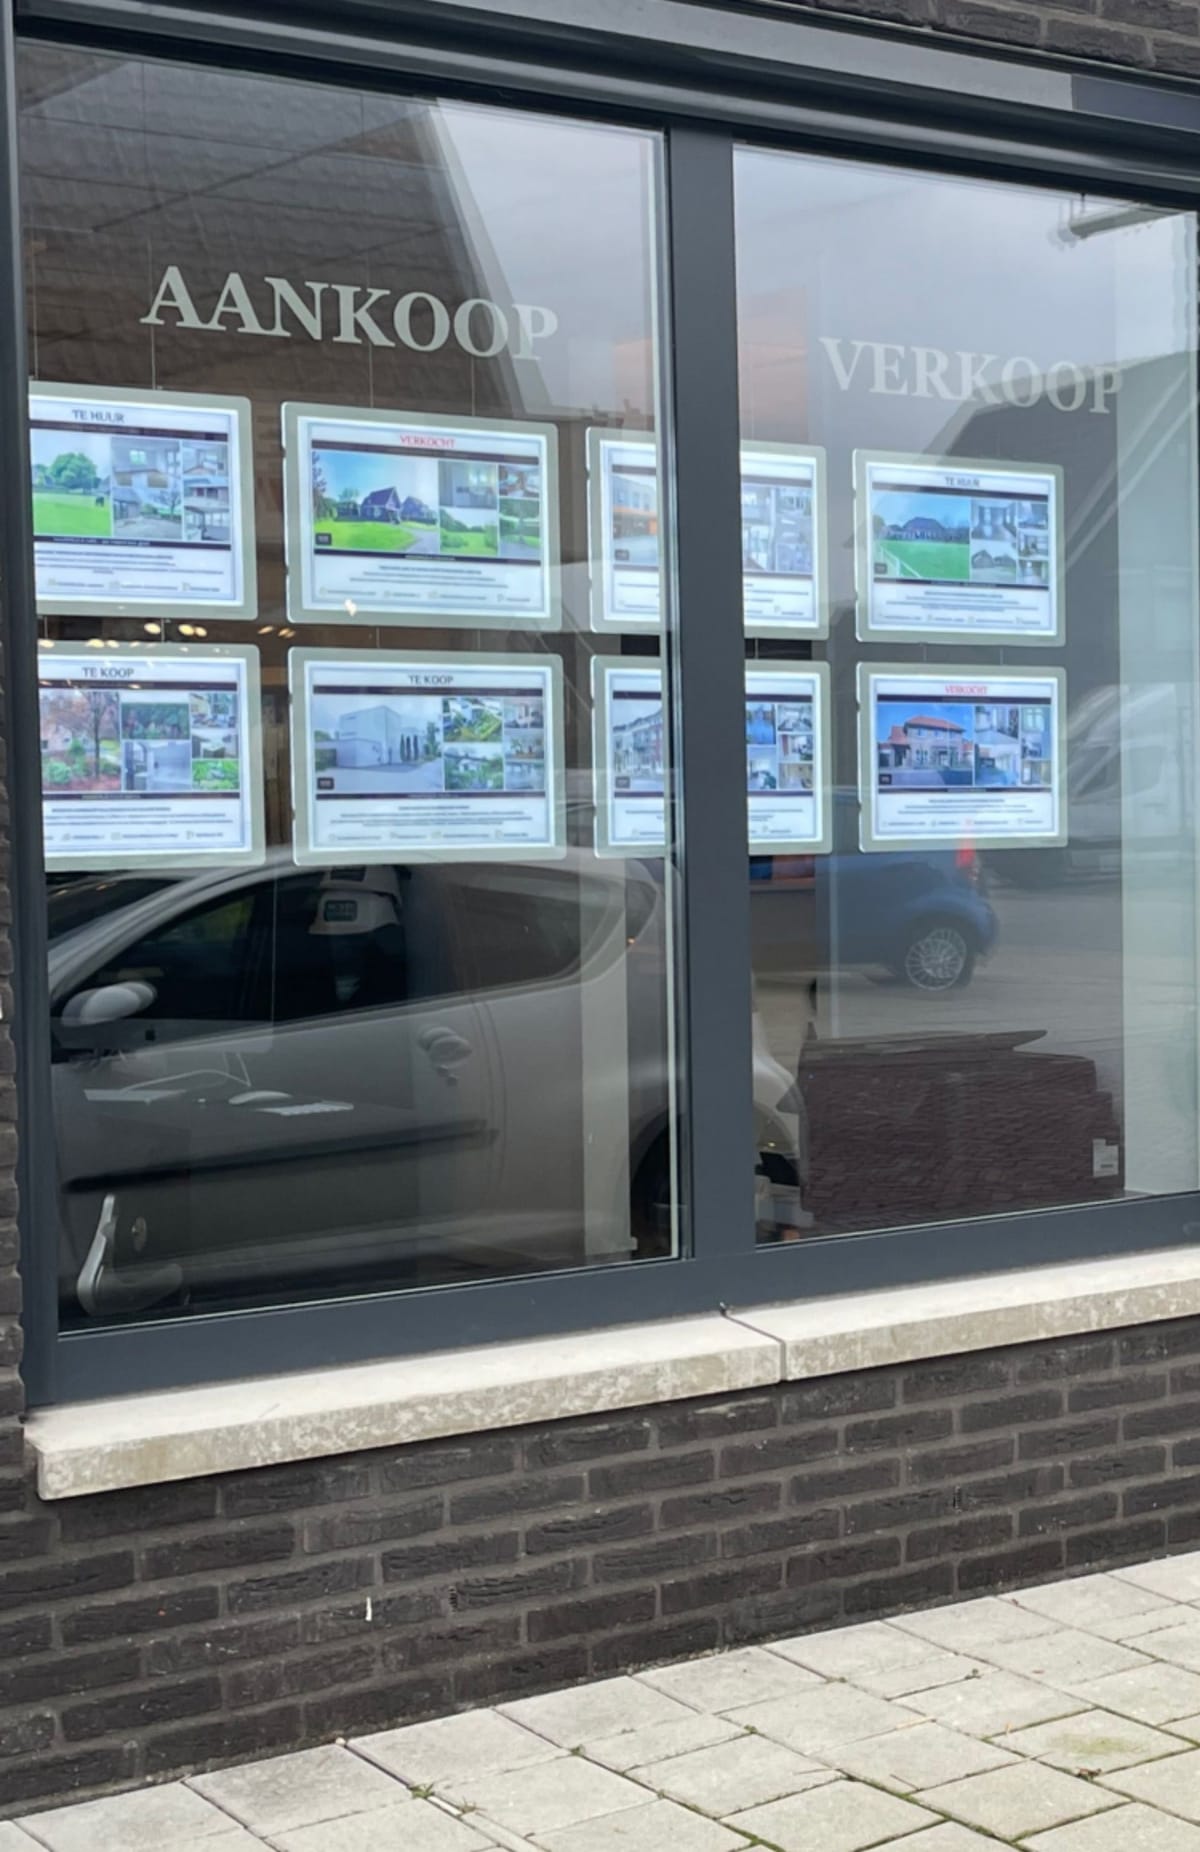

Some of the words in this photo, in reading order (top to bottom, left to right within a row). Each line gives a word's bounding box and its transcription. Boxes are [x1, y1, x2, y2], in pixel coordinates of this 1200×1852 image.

[140, 264, 559, 361] AANKOOP
[819, 336, 1124, 415] VERKOOP
[72, 408, 88, 420] TE
[89, 410, 126, 424] HUUR
[81, 666, 97, 678] TE
[99, 667, 135, 678] KOOP
[408, 674, 422, 685] TE
[423, 674, 454, 686] KOOP
